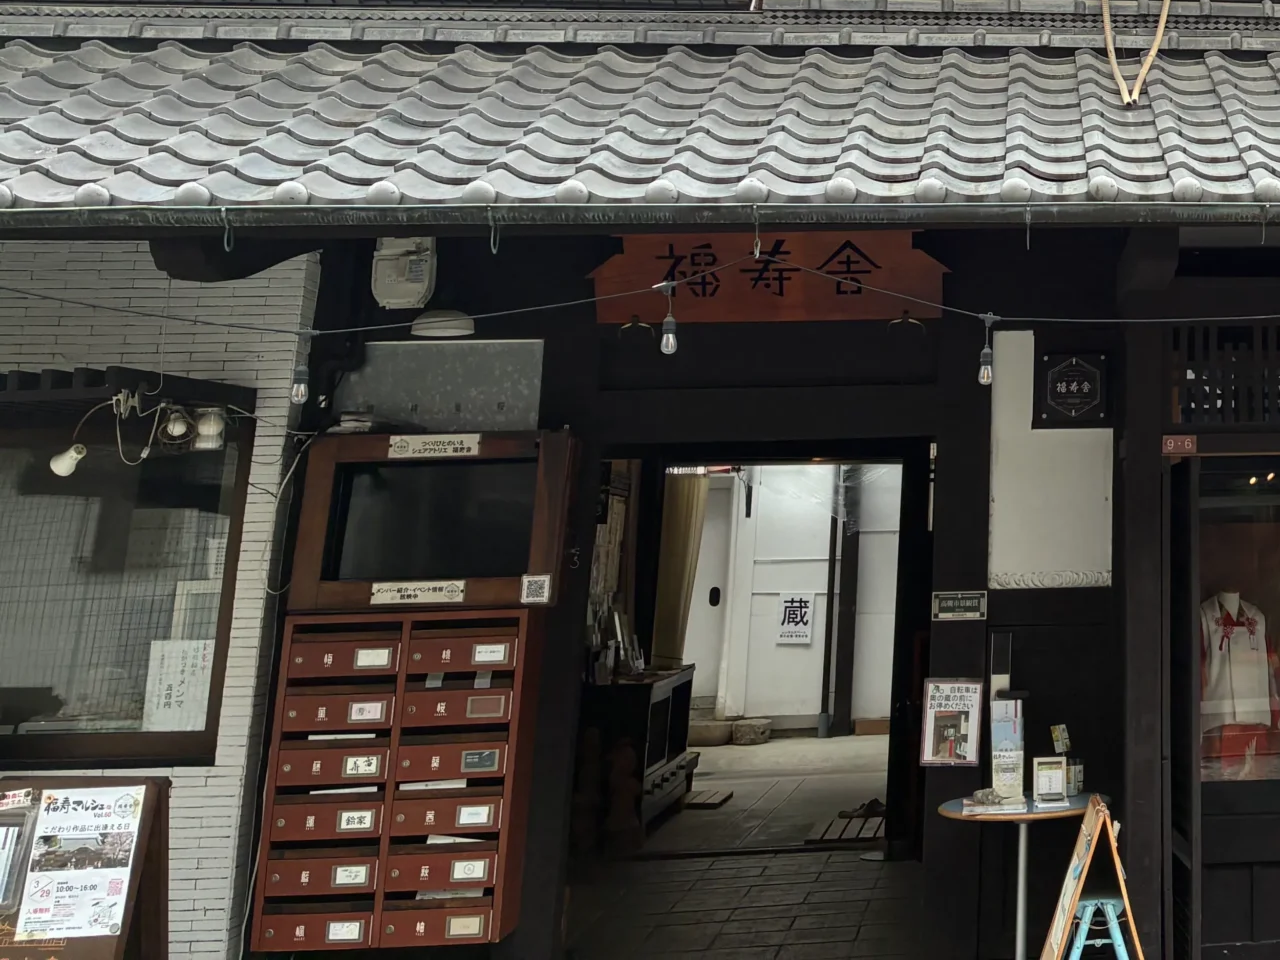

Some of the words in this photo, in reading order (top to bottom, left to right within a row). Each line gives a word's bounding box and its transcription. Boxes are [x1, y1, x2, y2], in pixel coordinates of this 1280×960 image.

[780, 597, 810, 626] 蔵
[949, 686, 979, 694] 自転車は
[929, 694, 973, 702] 奥の蔵の前に
[928, 702, 974, 710] お停めください
[44, 796, 104, 815] 福寿マルシェ
[40, 889, 51, 898] 29
